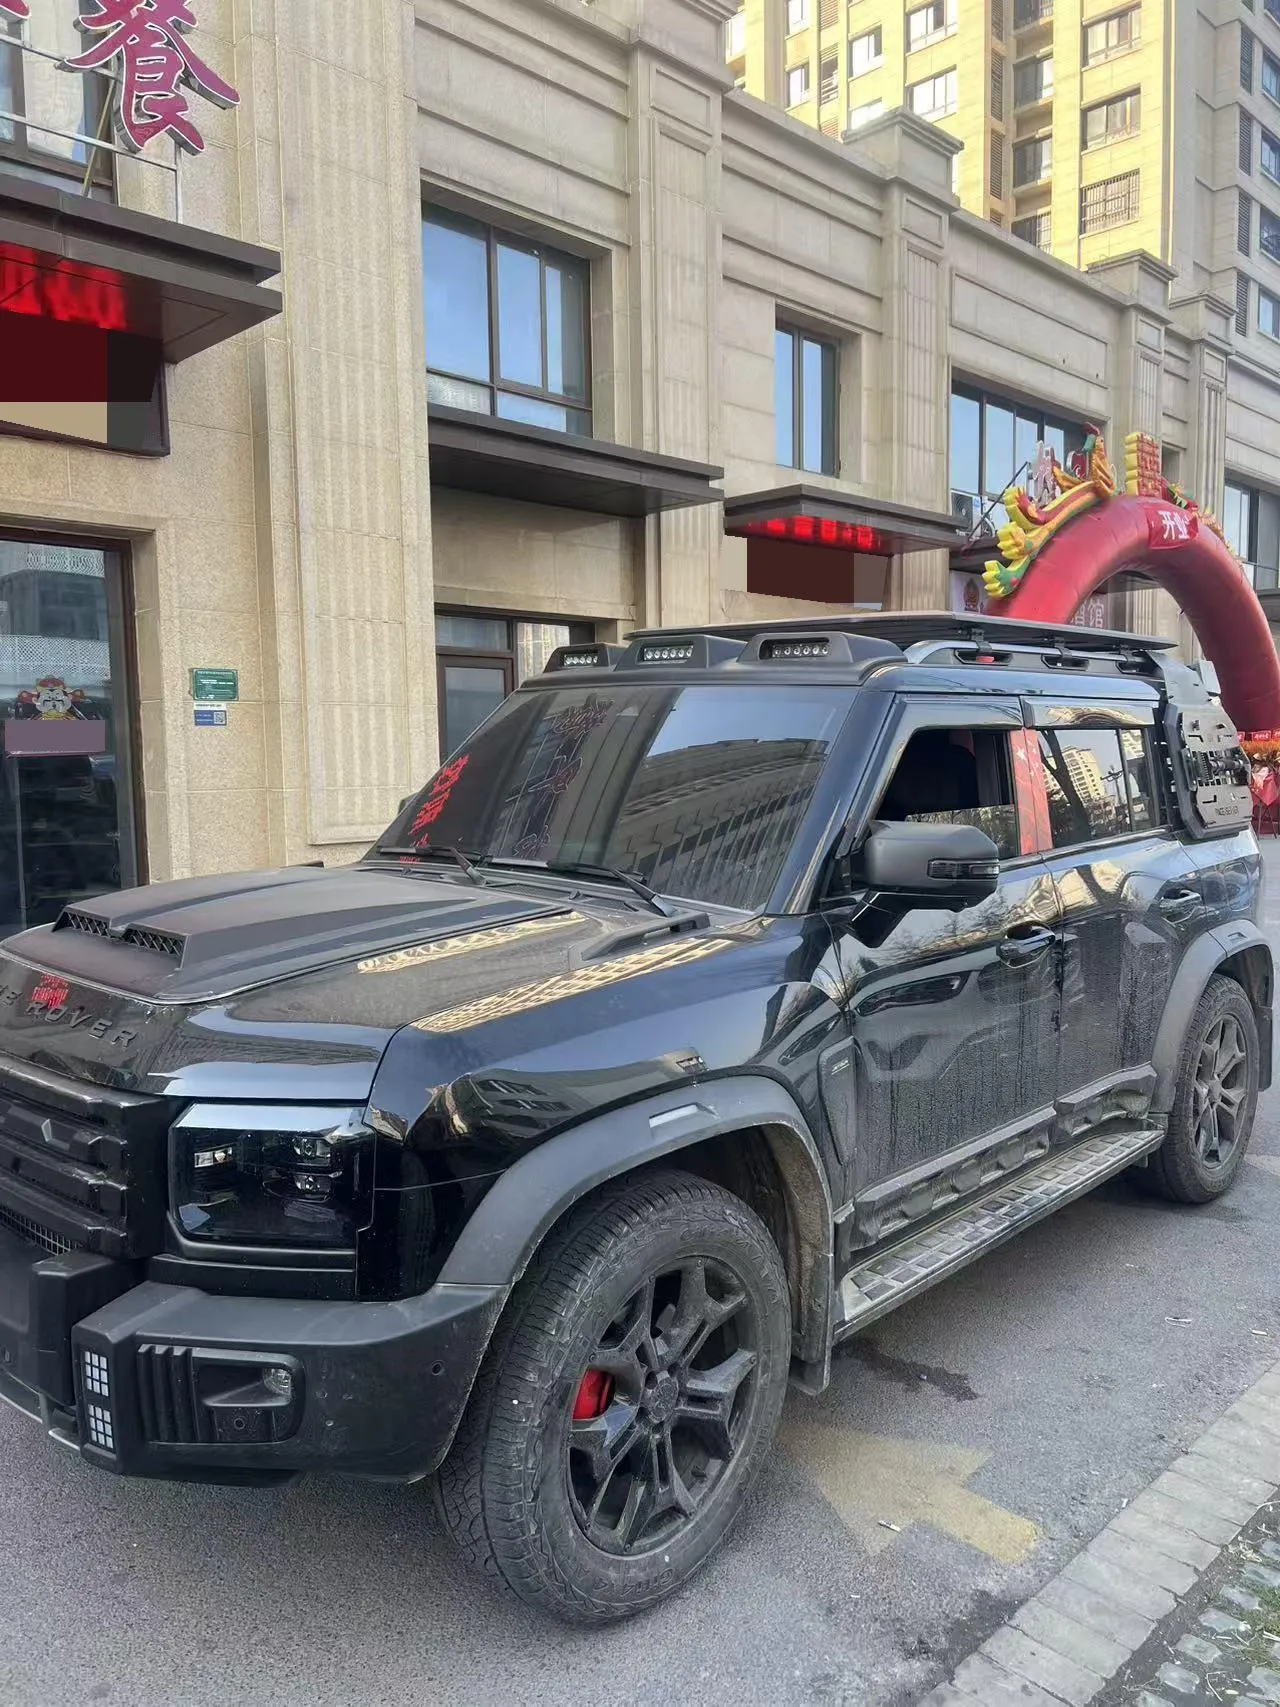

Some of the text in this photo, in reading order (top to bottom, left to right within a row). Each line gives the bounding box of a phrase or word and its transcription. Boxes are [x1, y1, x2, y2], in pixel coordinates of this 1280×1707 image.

[64, 0, 241, 152] 餐
[1157, 509, 1191, 541] 开业
[25, 1001, 139, 1048] ROVER
